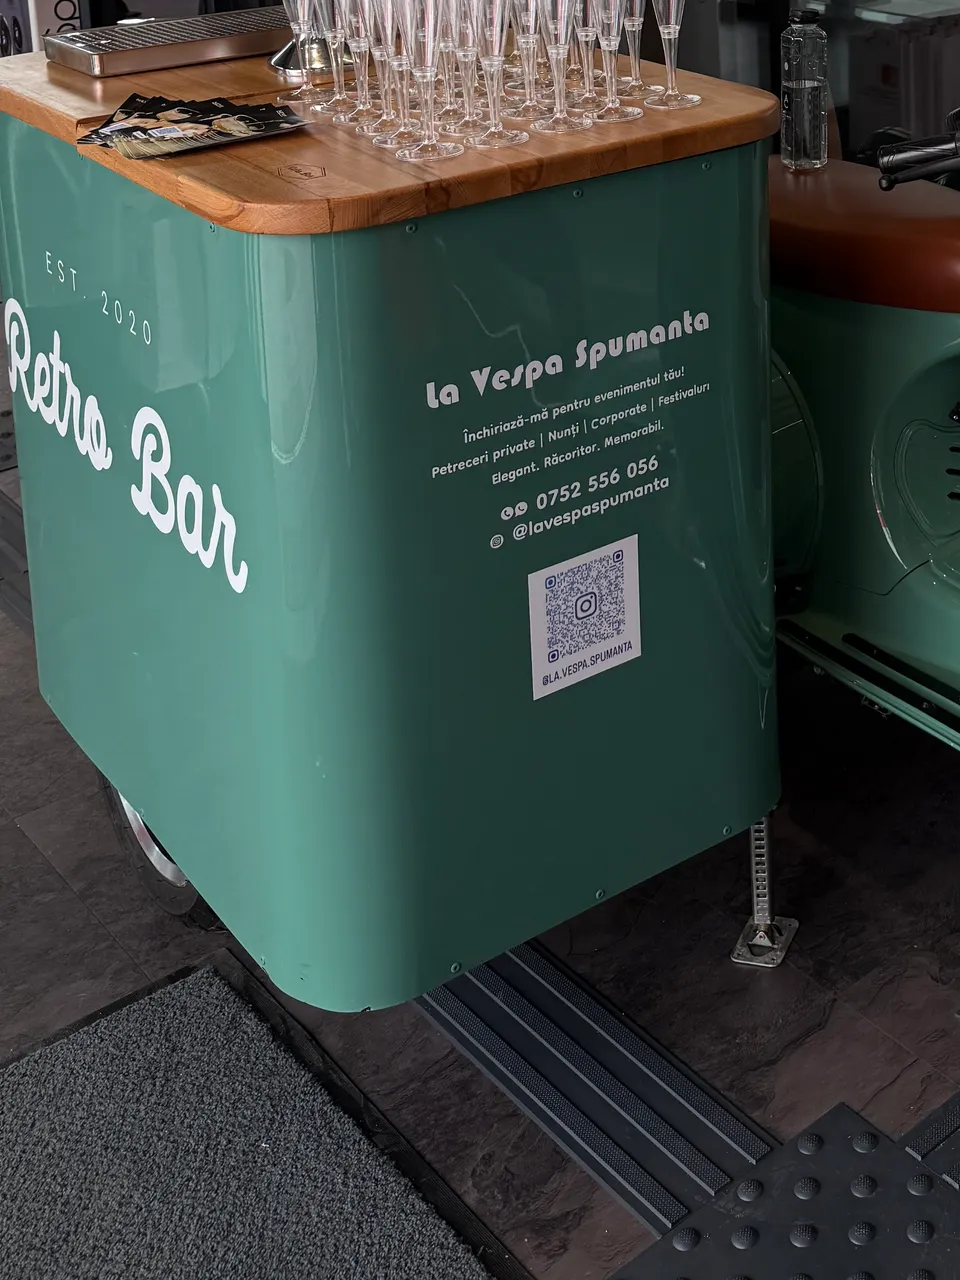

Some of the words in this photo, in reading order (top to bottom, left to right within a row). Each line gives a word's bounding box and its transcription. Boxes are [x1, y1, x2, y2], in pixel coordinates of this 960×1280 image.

[45, 250, 87, 300] EST.
[101, 290, 152, 346] 2020
[425, 381, 460, 409] La
[470, 354, 563, 397] Vespa
[575, 310, 710, 370] Spumanta
[431, 452, 489, 479] Petreceri
[492, 436, 536, 463] private
[591, 402, 647, 431] Corporate
[462, 408, 549, 444] Închiriază-mă
[552, 396, 591, 419] pentru
[594, 373, 661, 404] evenimentul
[663, 366, 685, 384] tău!
[4, 297, 113, 472] Retro
[130, 406, 249, 594] Bar
[491, 462, 540, 486] Elegant.
[544, 442, 601, 469] Răcoritor.
[604, 419, 665, 449] Memorabil.
[536, 481, 582, 510] 0752
[588, 468, 620, 493] 556
[626, 455, 659, 480] 056
[512, 477, 670, 541] @lavespaspumanta
[542, 640, 633, 687] @LA.VESPA.SPUMANTA
